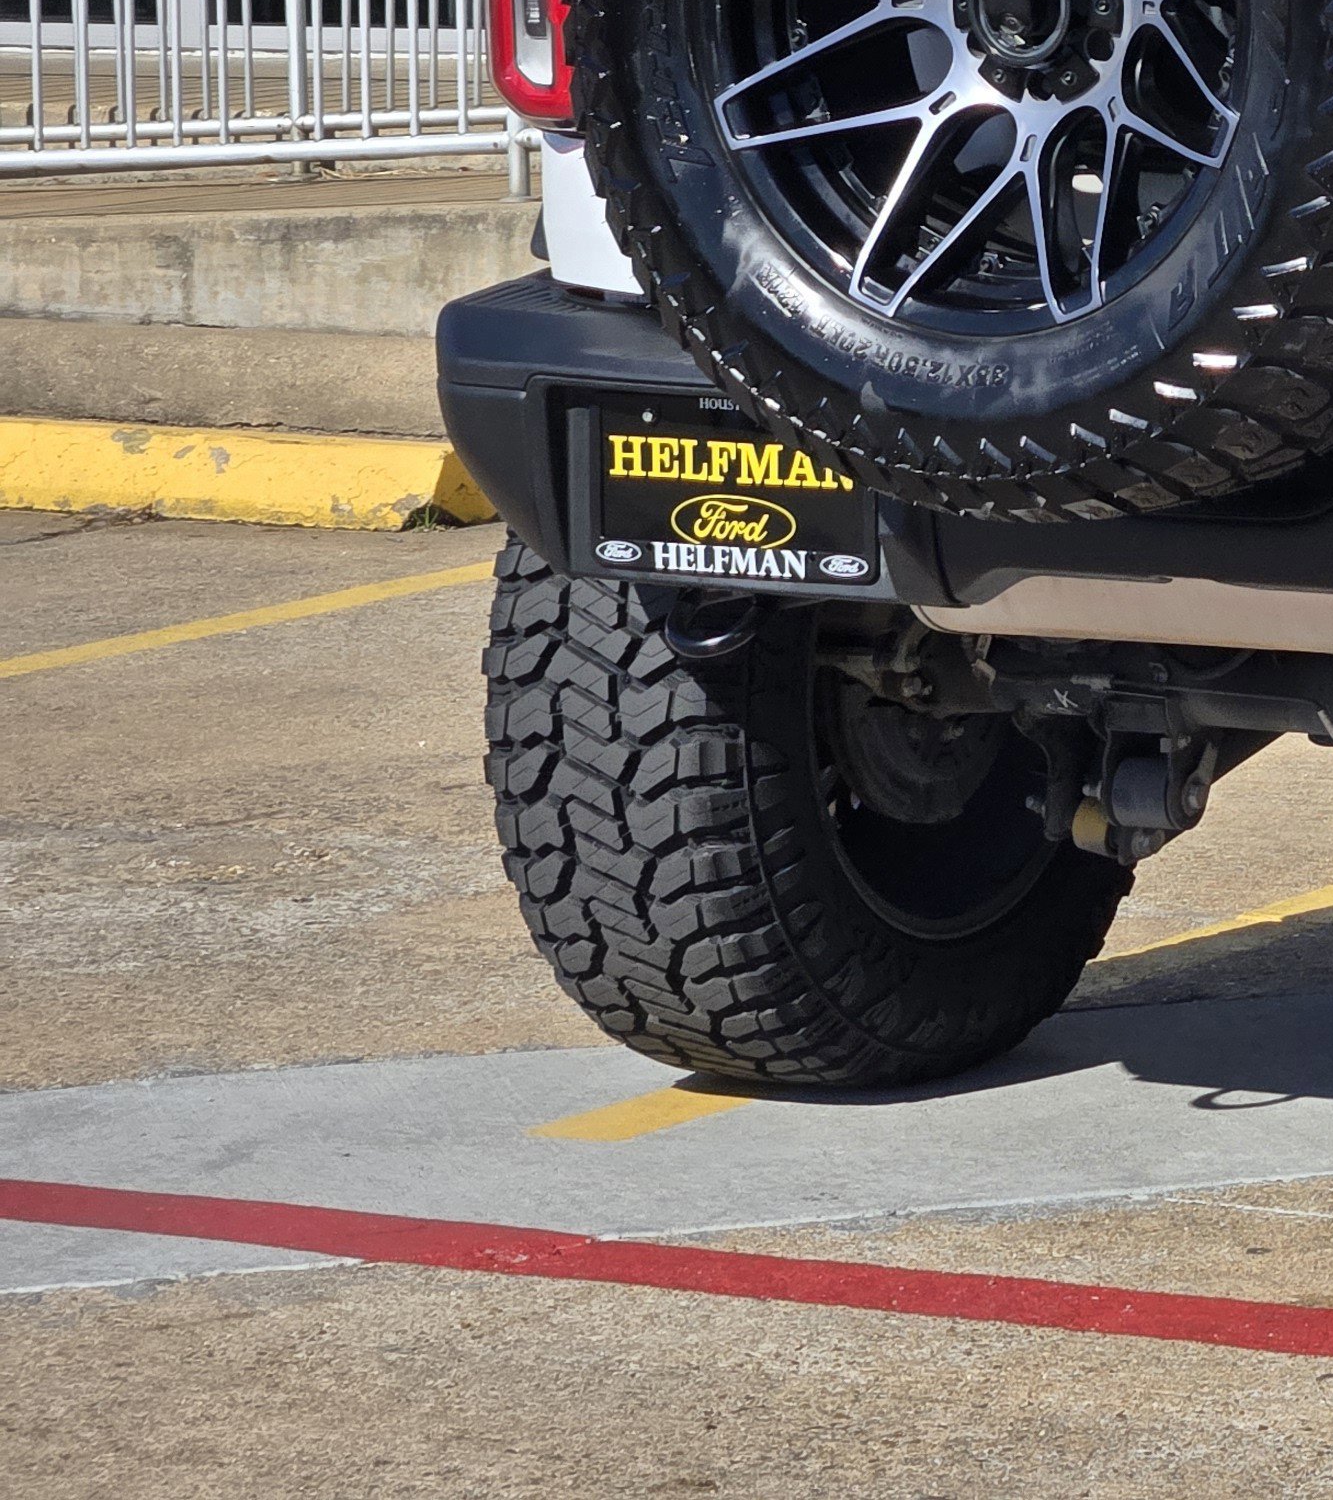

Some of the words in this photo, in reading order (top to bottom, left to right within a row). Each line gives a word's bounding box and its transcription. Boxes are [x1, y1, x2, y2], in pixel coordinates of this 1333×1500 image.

[693, 500, 771, 543] Ford
[603, 544, 633, 560] Ford
[650, 541, 808, 580] HELFMAN
[828, 558, 859, 574] Ford
